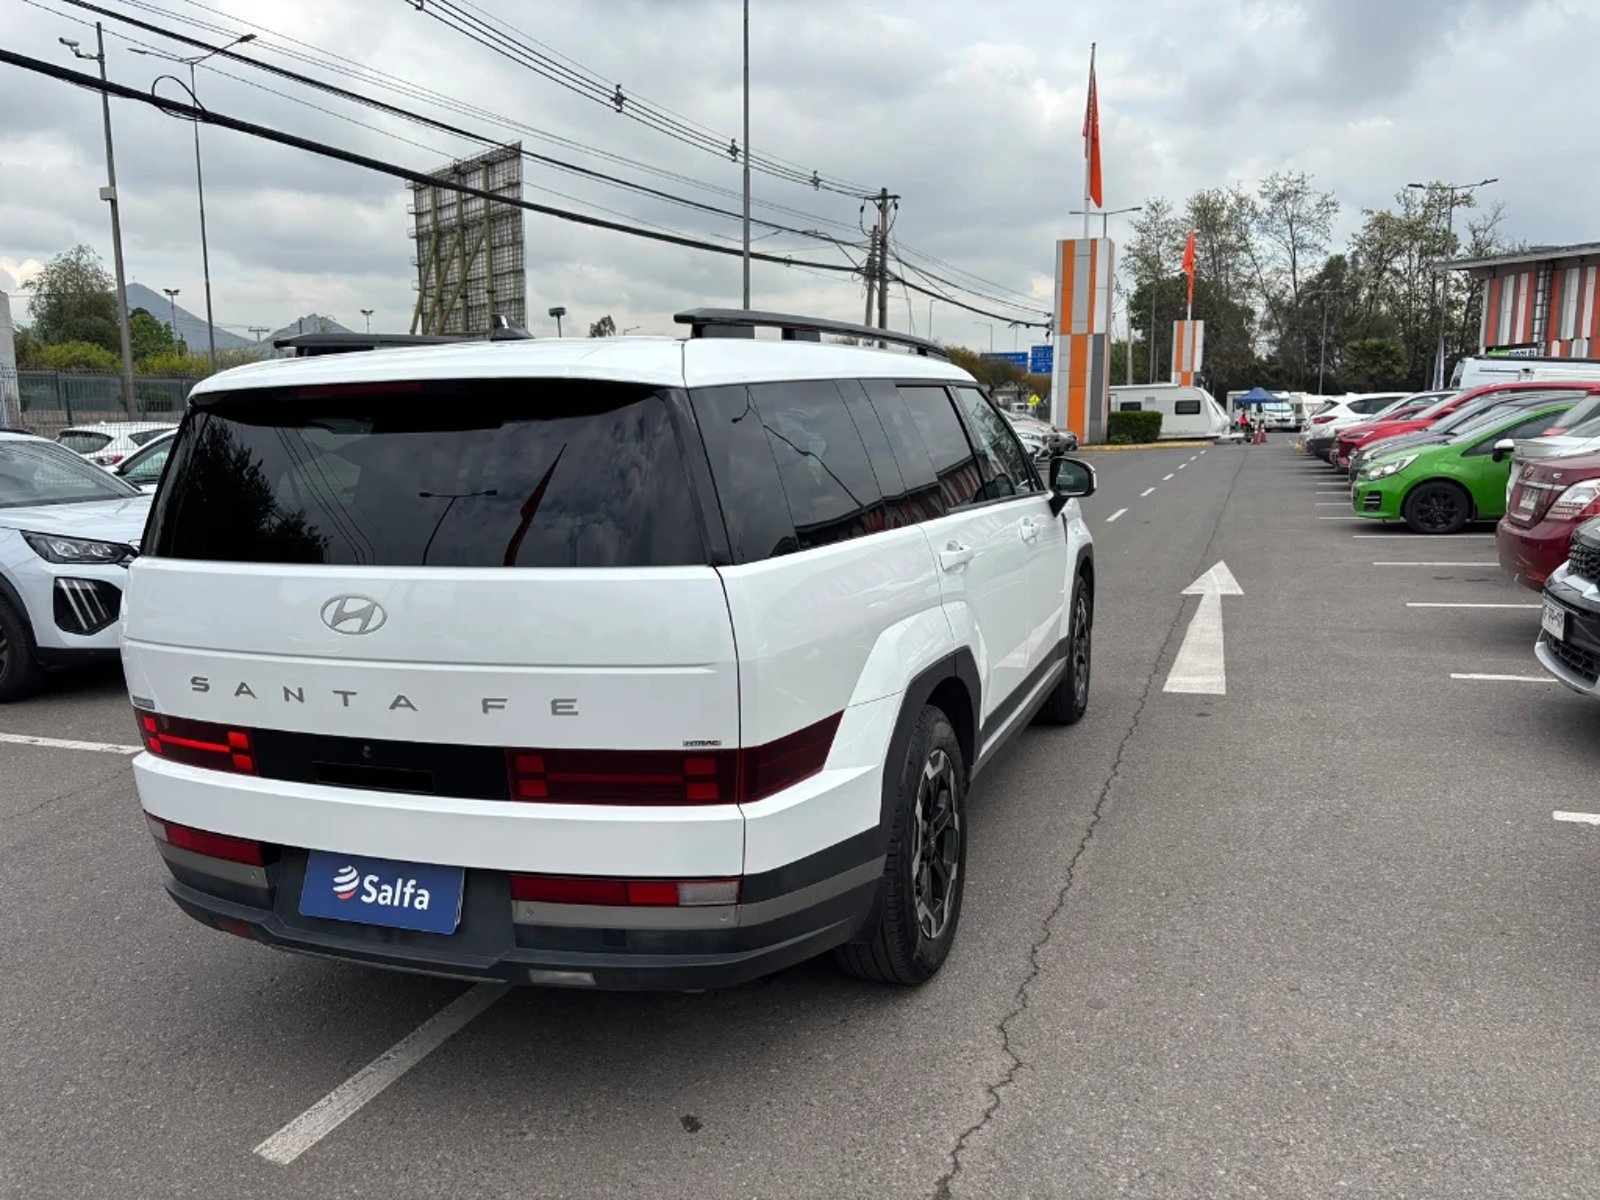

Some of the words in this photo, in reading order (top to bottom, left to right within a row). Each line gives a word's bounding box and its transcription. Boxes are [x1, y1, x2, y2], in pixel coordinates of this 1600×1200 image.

[190, 675, 418, 712] SANTA
[481, 697, 579, 717] FE
[360, 864, 431, 911] Salfa
